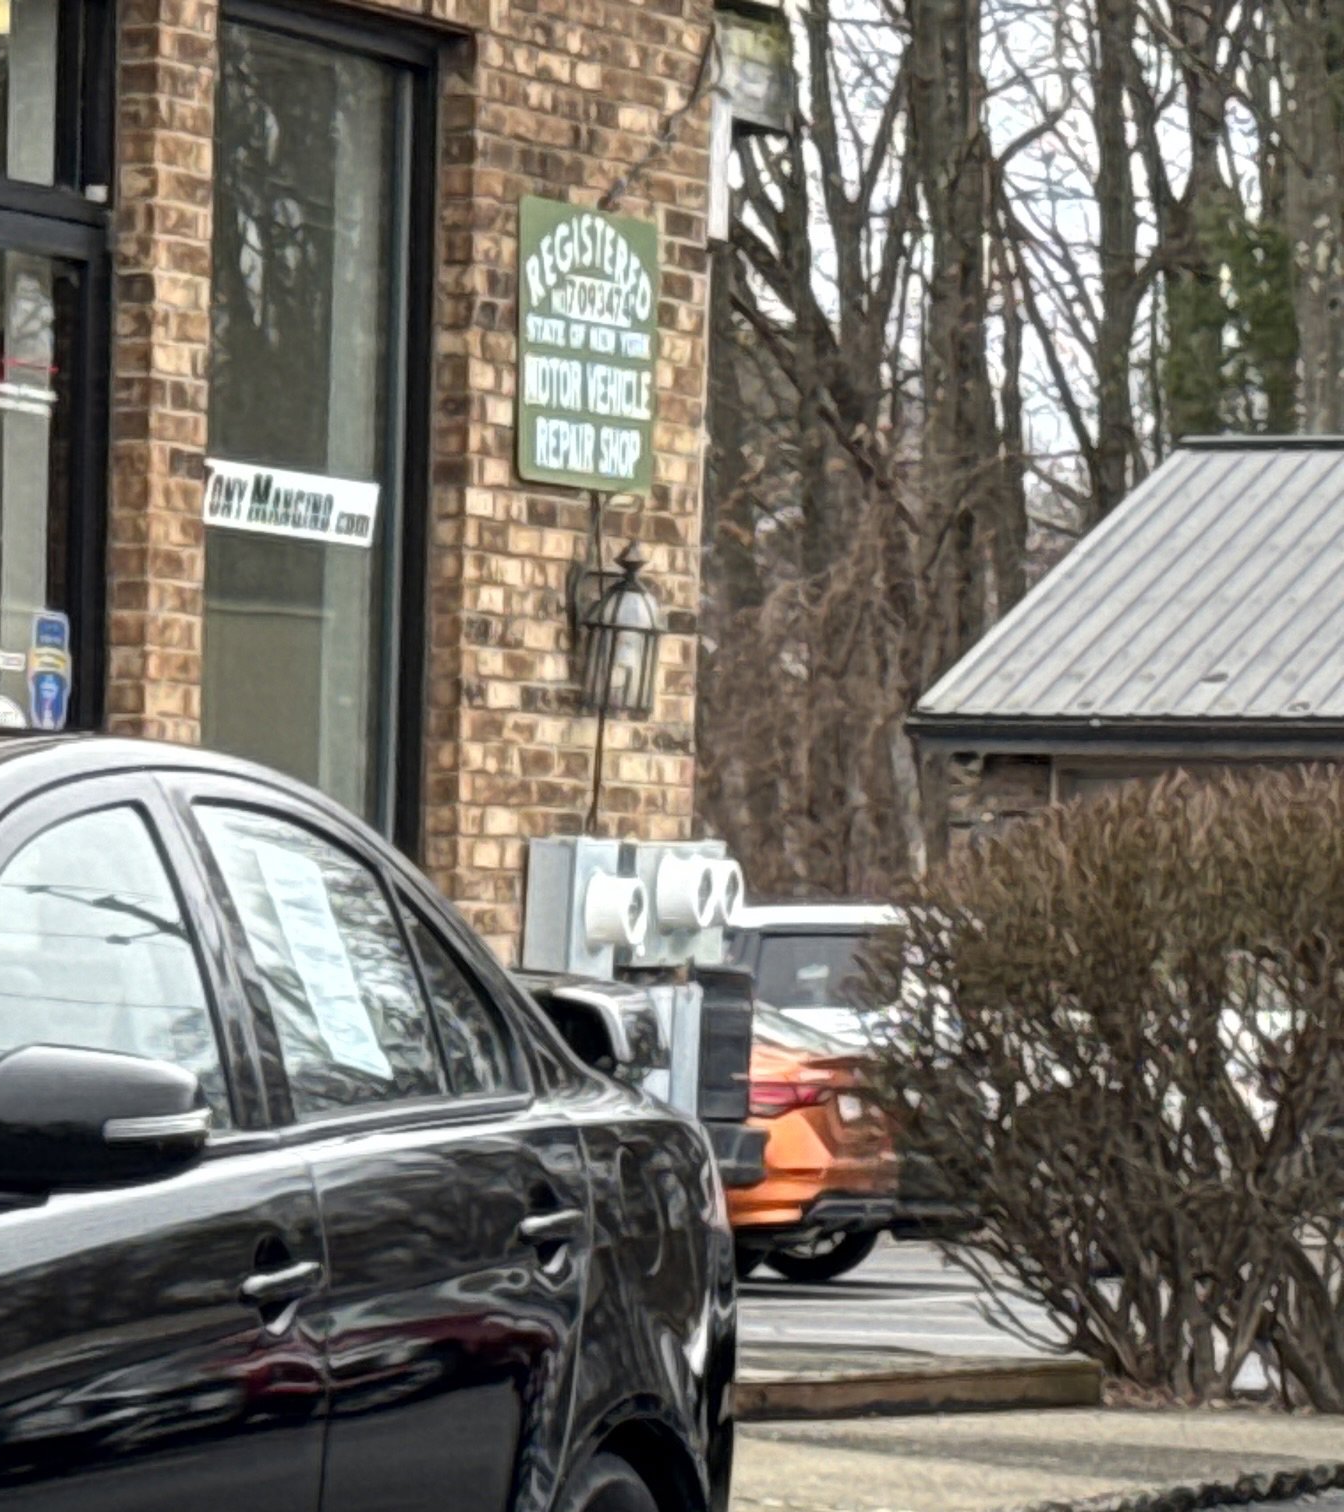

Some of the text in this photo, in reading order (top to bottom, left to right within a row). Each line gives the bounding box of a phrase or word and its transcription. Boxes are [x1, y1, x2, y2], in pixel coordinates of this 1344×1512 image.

[525, 213, 652, 321] REGISTERED
[524, 351, 651, 420] MOTOR VEHICLE
[535, 415, 641, 478] REPAIR SHOP
